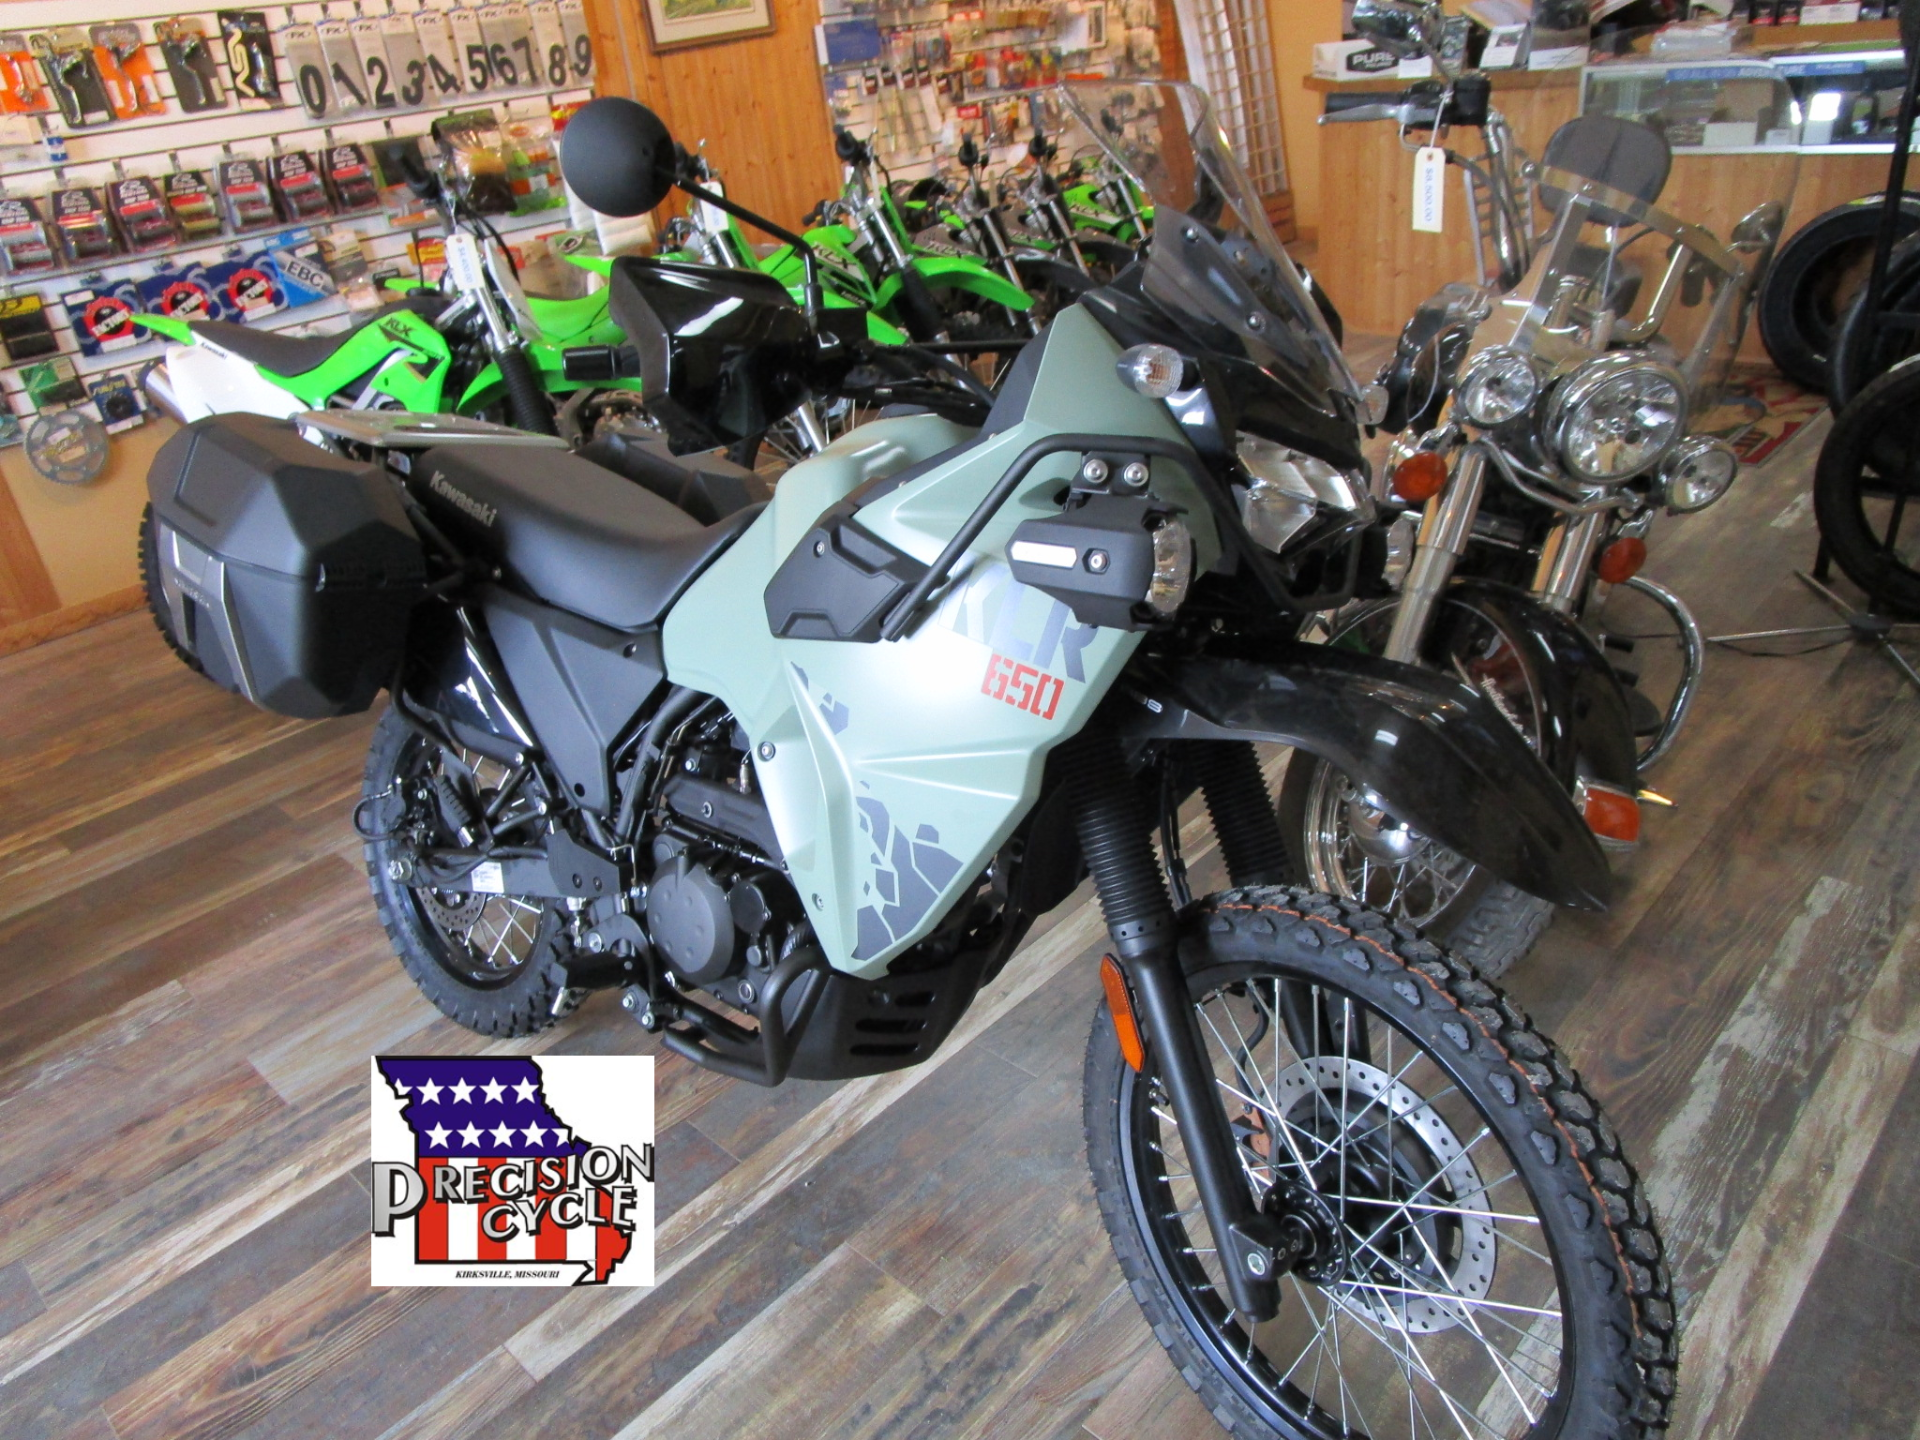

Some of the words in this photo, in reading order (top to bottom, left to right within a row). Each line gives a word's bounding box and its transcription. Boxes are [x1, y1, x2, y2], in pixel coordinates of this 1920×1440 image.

[427, 54, 461, 93] 4
[466, 45, 488, 90] 5
[490, 44, 518, 86] 6
[512, 37, 538, 83] 7
[549, 44, 566, 86] 8
[575, 34, 592, 77] 9
[299, 64, 327, 118] 0
[332, 62, 367, 106] 1
[366, 56, 396, 109] 2
[402, 60, 425, 105] 3
[285, 260, 324, 288] EBC
[385, 317, 414, 337] KLX
[430, 470, 497, 527] Kawasaki
[980, 653, 1065, 720] 650
